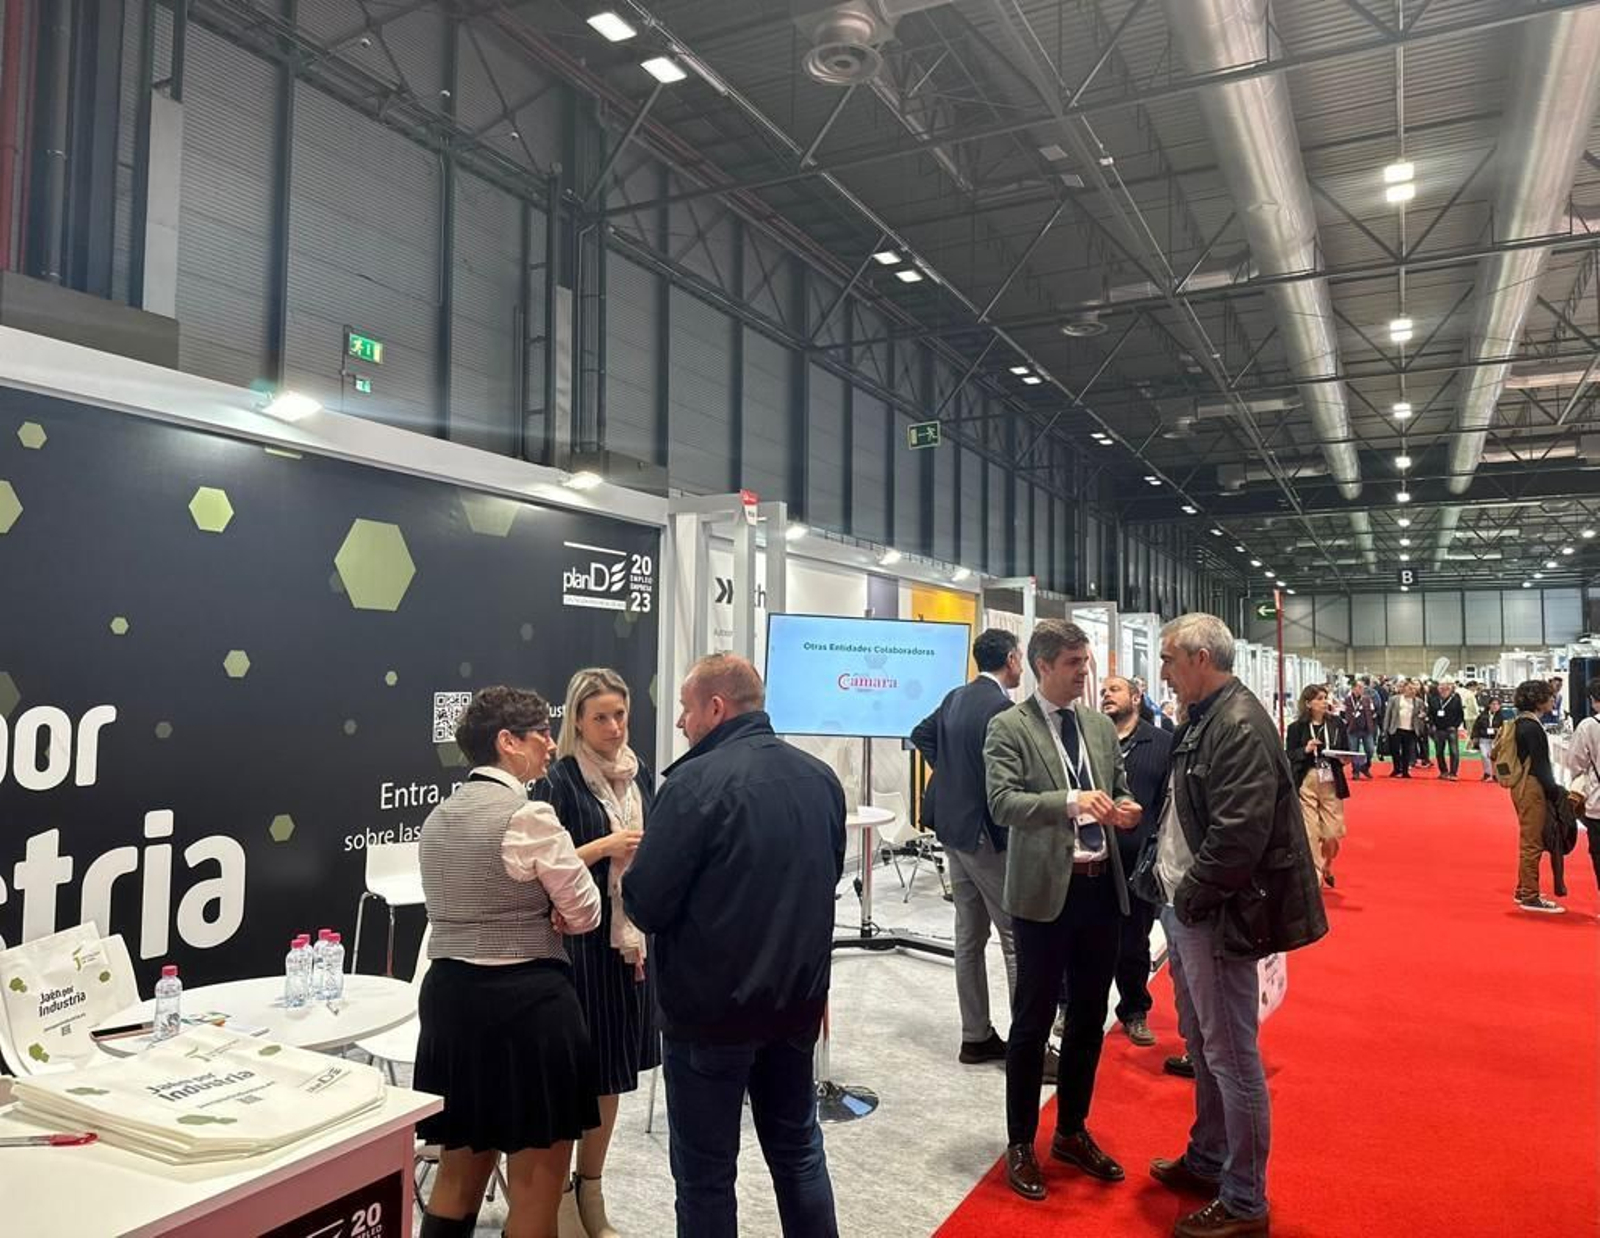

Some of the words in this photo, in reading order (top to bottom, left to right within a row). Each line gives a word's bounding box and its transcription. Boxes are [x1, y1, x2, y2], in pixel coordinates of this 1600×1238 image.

[631, 554, 652, 576] 20
[1402, 570, 1413, 584] B
[630, 591, 651, 613] 23
[803, 641, 827, 651] Otras
[829, 643, 871, 653] Entidades
[874, 645, 935, 656] Colaboradoras
[0, 704, 117, 791] or
[380, 781, 445, 810] Entra,
[344, 827, 396, 851] sobre
[399, 822, 421, 842] las
[0, 809, 246, 960] tria
[39, 991, 86, 1018] Industria
[158, 1069, 256, 1103] Industria
[351, 1202, 382, 1237] 20
